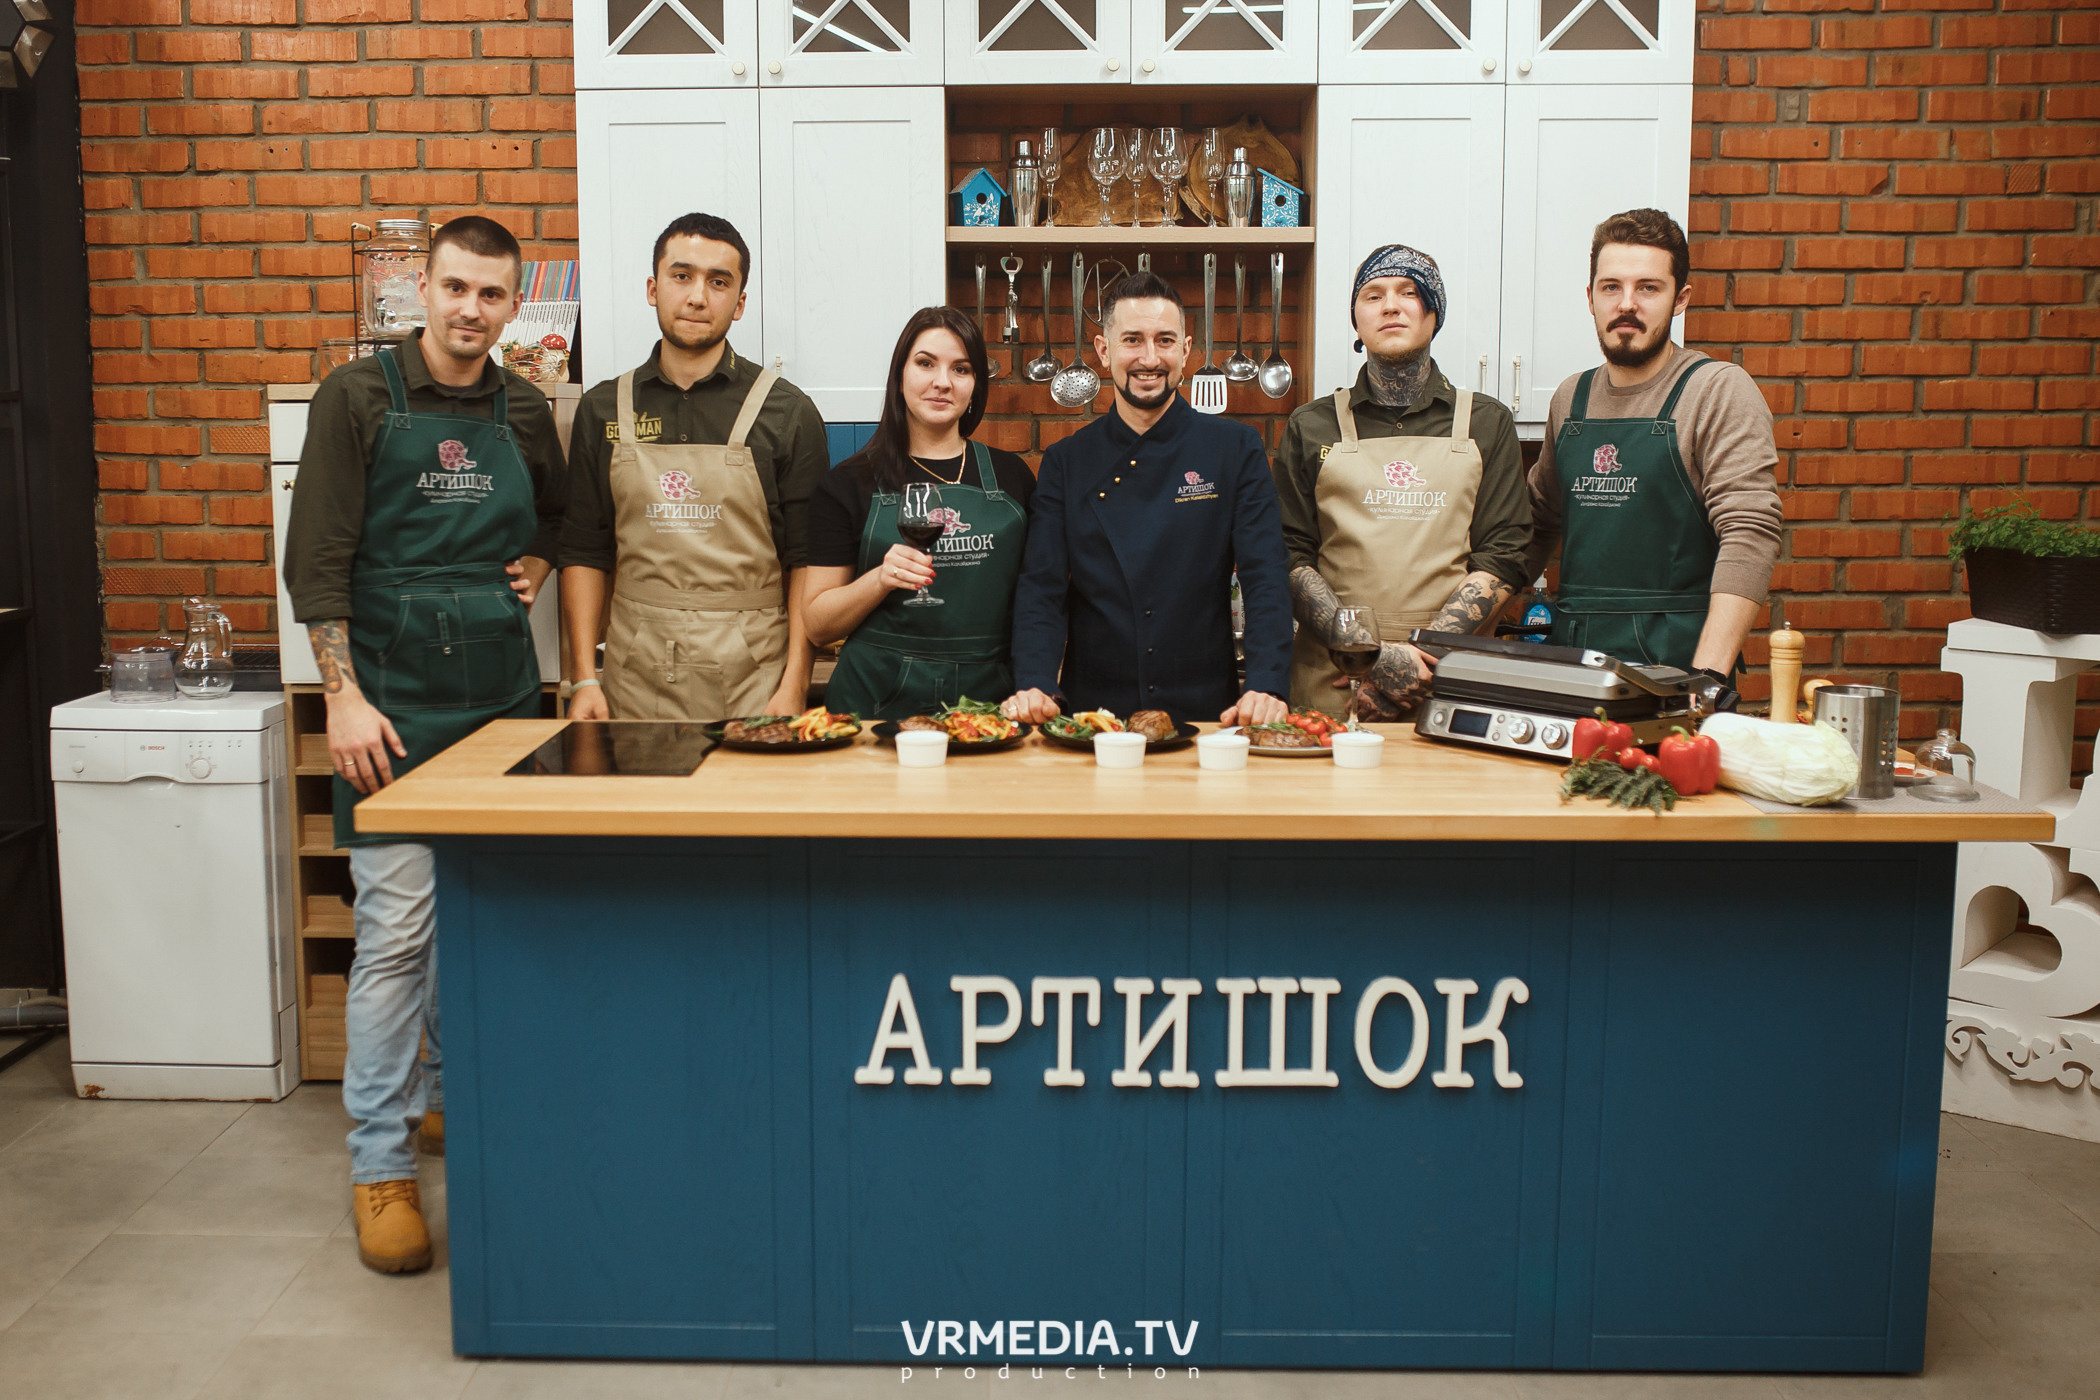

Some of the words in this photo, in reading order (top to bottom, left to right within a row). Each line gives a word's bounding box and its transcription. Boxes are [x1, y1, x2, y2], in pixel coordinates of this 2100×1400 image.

[605, 420, 662, 439] GOMAN
[416, 472, 494, 491] АРТИШОК
[1178, 482, 1215, 494] АРТИШОК
[1571, 476, 1638, 492] АРТИШОК
[1362, 489, 1447, 507] АРТИШОК
[936, 534, 994, 553] ТИШОК
[854, 972, 1529, 1090] АРТИШОК
